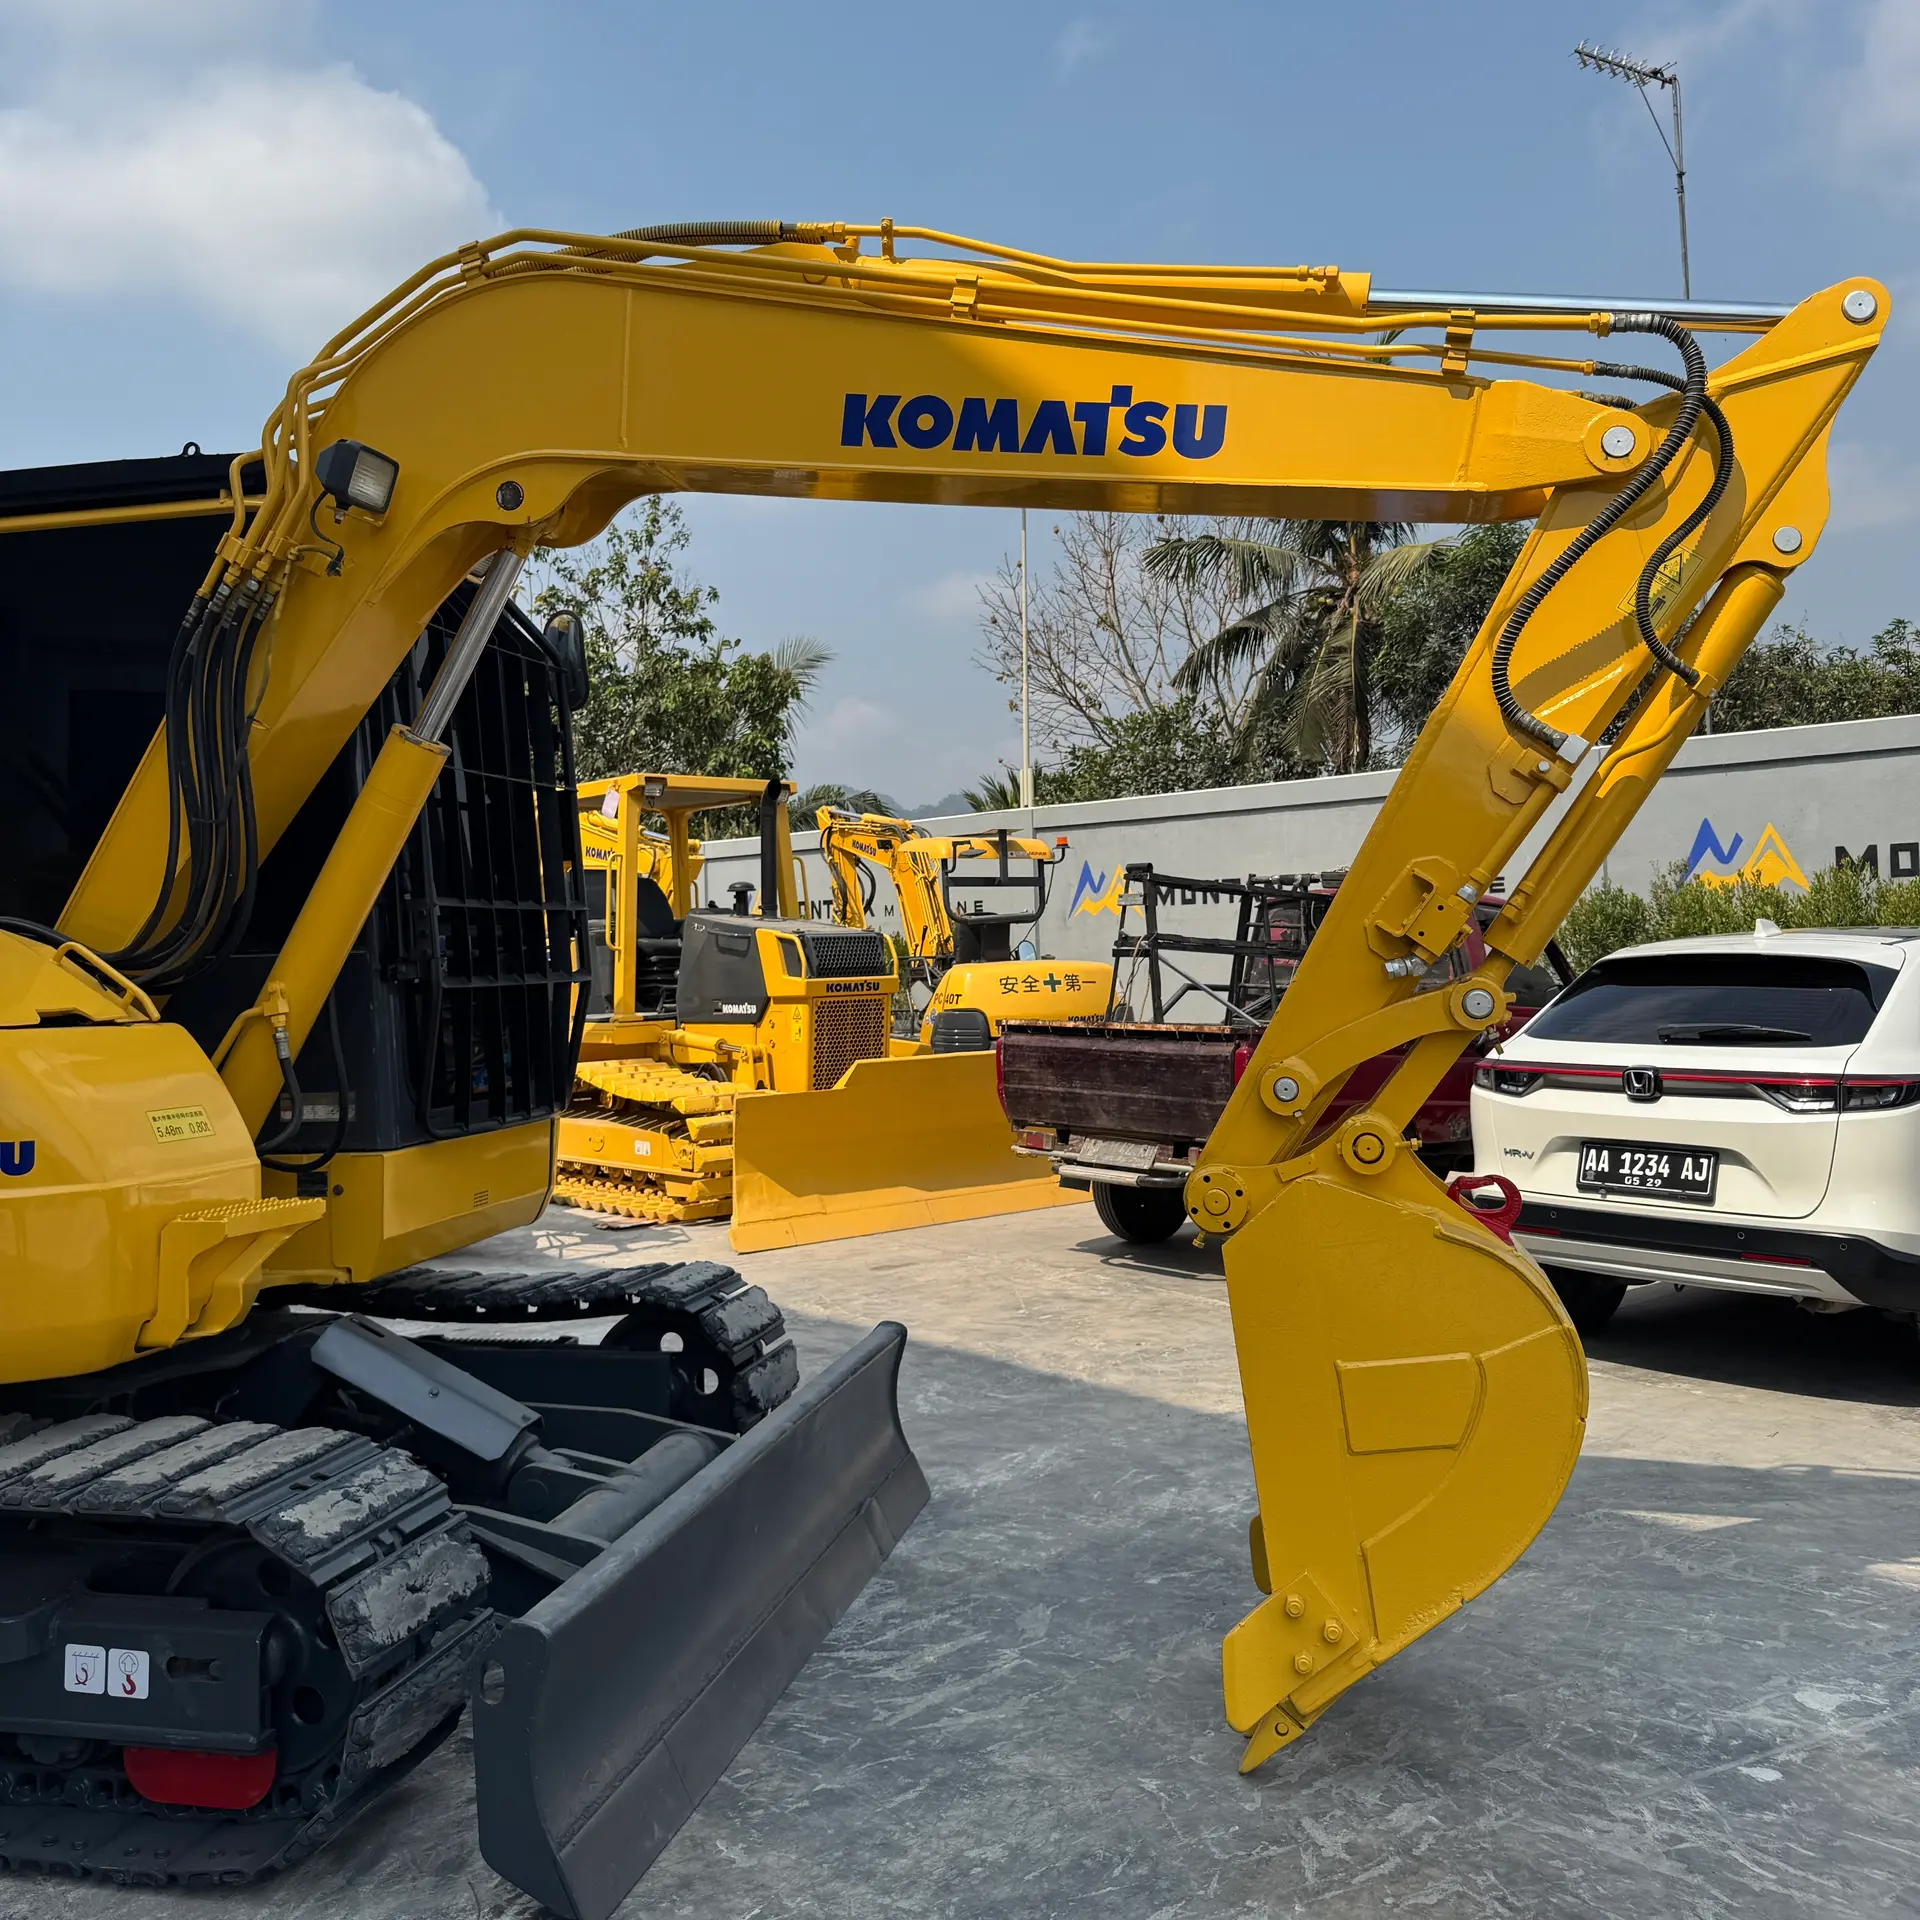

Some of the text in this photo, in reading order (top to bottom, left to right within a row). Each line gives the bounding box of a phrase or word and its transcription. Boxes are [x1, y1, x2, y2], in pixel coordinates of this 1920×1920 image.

[841, 385, 1228, 460] KOMATSU
[852, 839, 877, 857] KOMATSU
[826, 980, 880, 993] KOMATSU
[723, 1002, 757, 1014] KOMATSU
[156, 1120, 211, 1138] 5.48m 0.80t
[1585, 1148, 1709, 1181] AA 1234 AJ
[1646, 1178, 1662, 1187] 29
